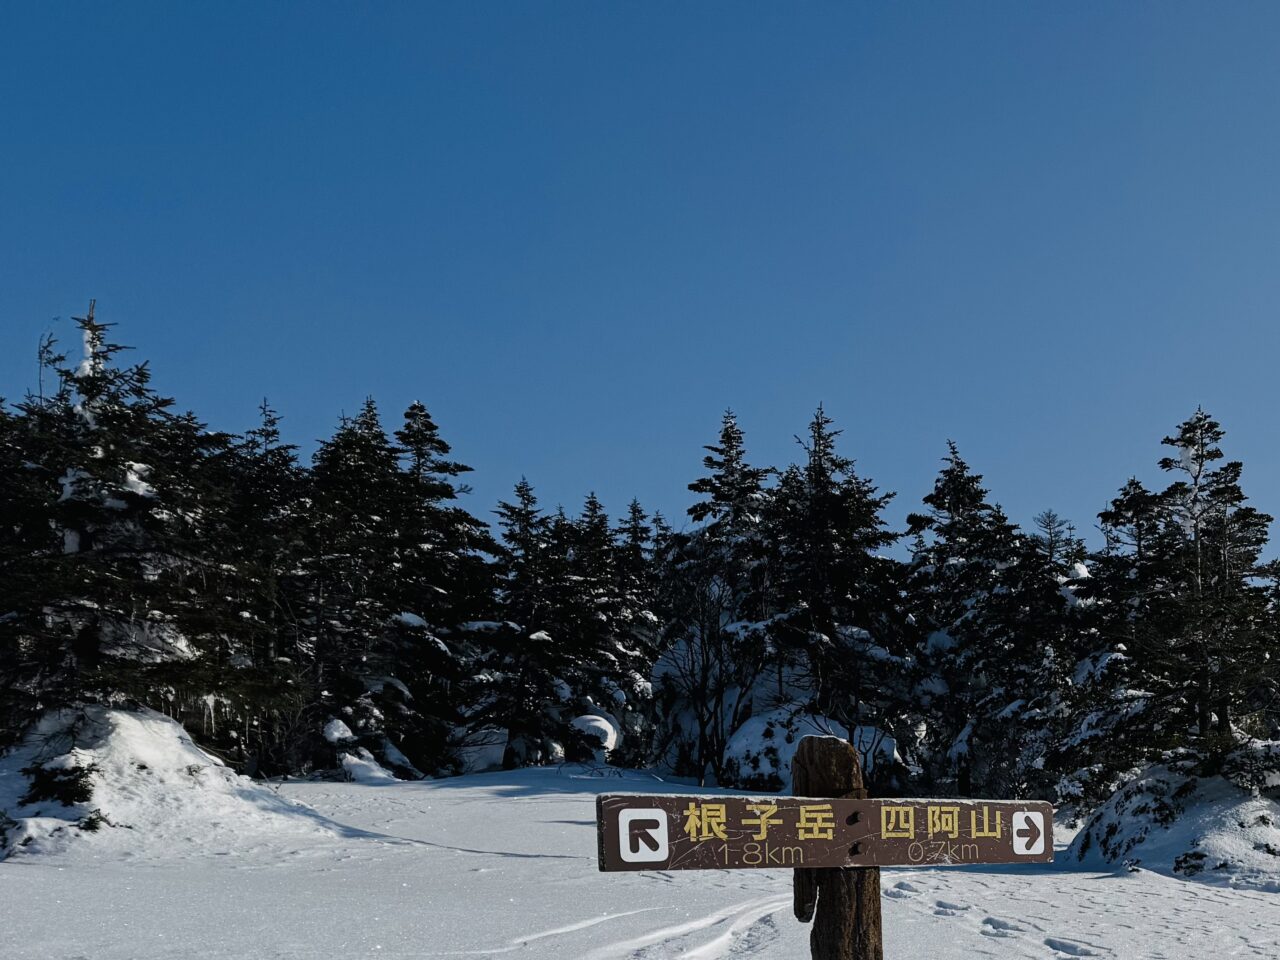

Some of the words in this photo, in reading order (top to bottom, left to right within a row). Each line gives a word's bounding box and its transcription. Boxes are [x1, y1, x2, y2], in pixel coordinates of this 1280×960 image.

[683, 802, 836, 842] 根子岳
[881, 806, 1001, 840] 四阿山
[718, 842, 804, 865] 1.8km
